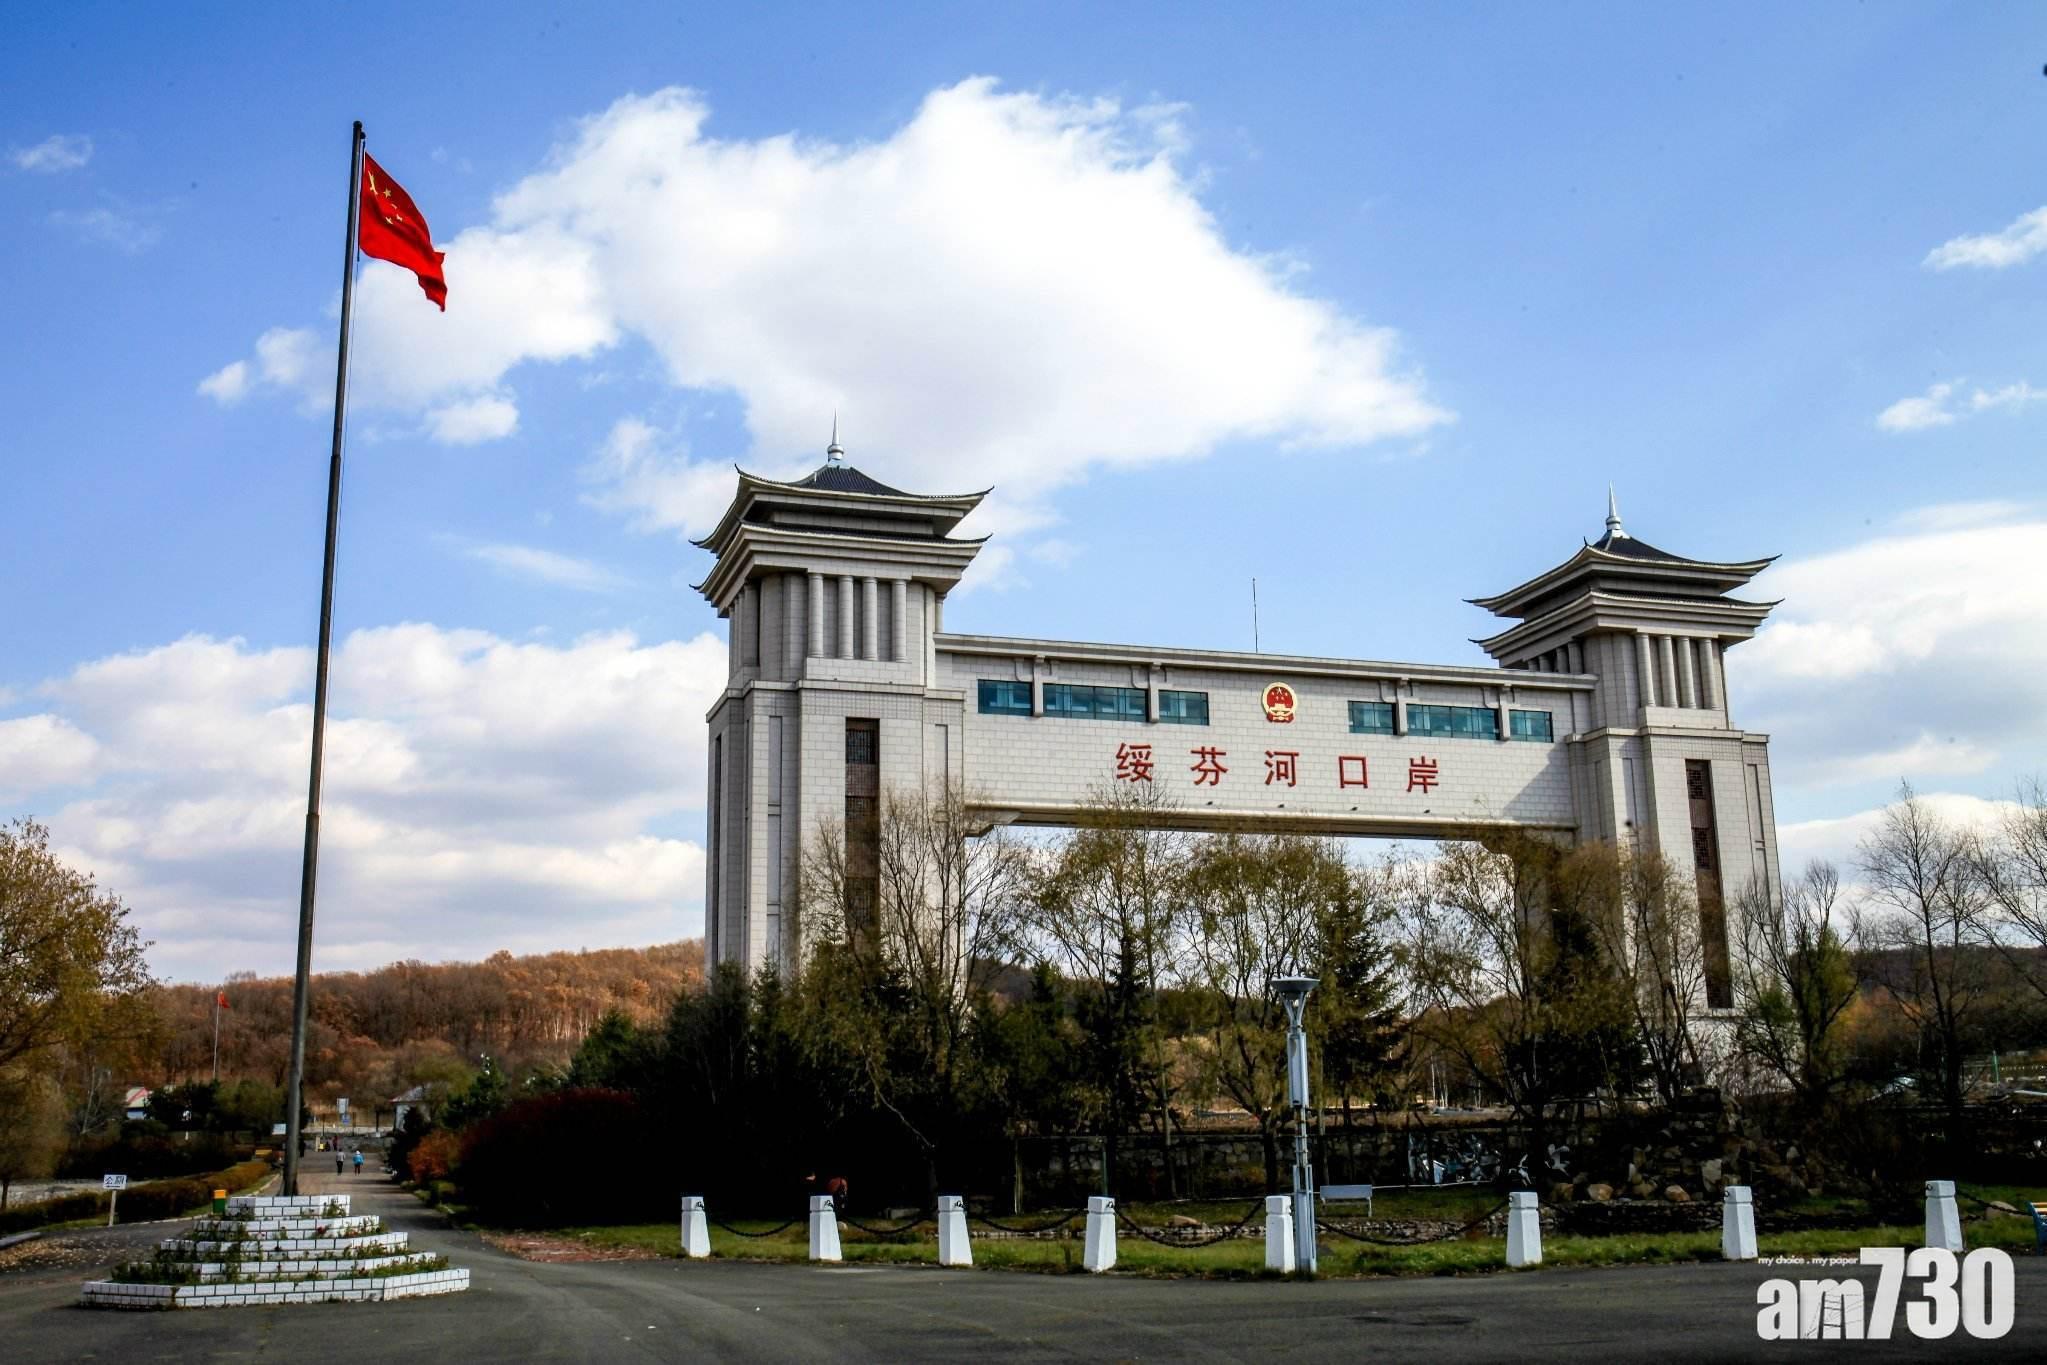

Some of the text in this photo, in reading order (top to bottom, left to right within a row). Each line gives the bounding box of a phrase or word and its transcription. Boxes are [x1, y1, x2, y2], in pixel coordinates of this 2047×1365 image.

[1115, 742, 1439, 794] 绥芬河口岸
